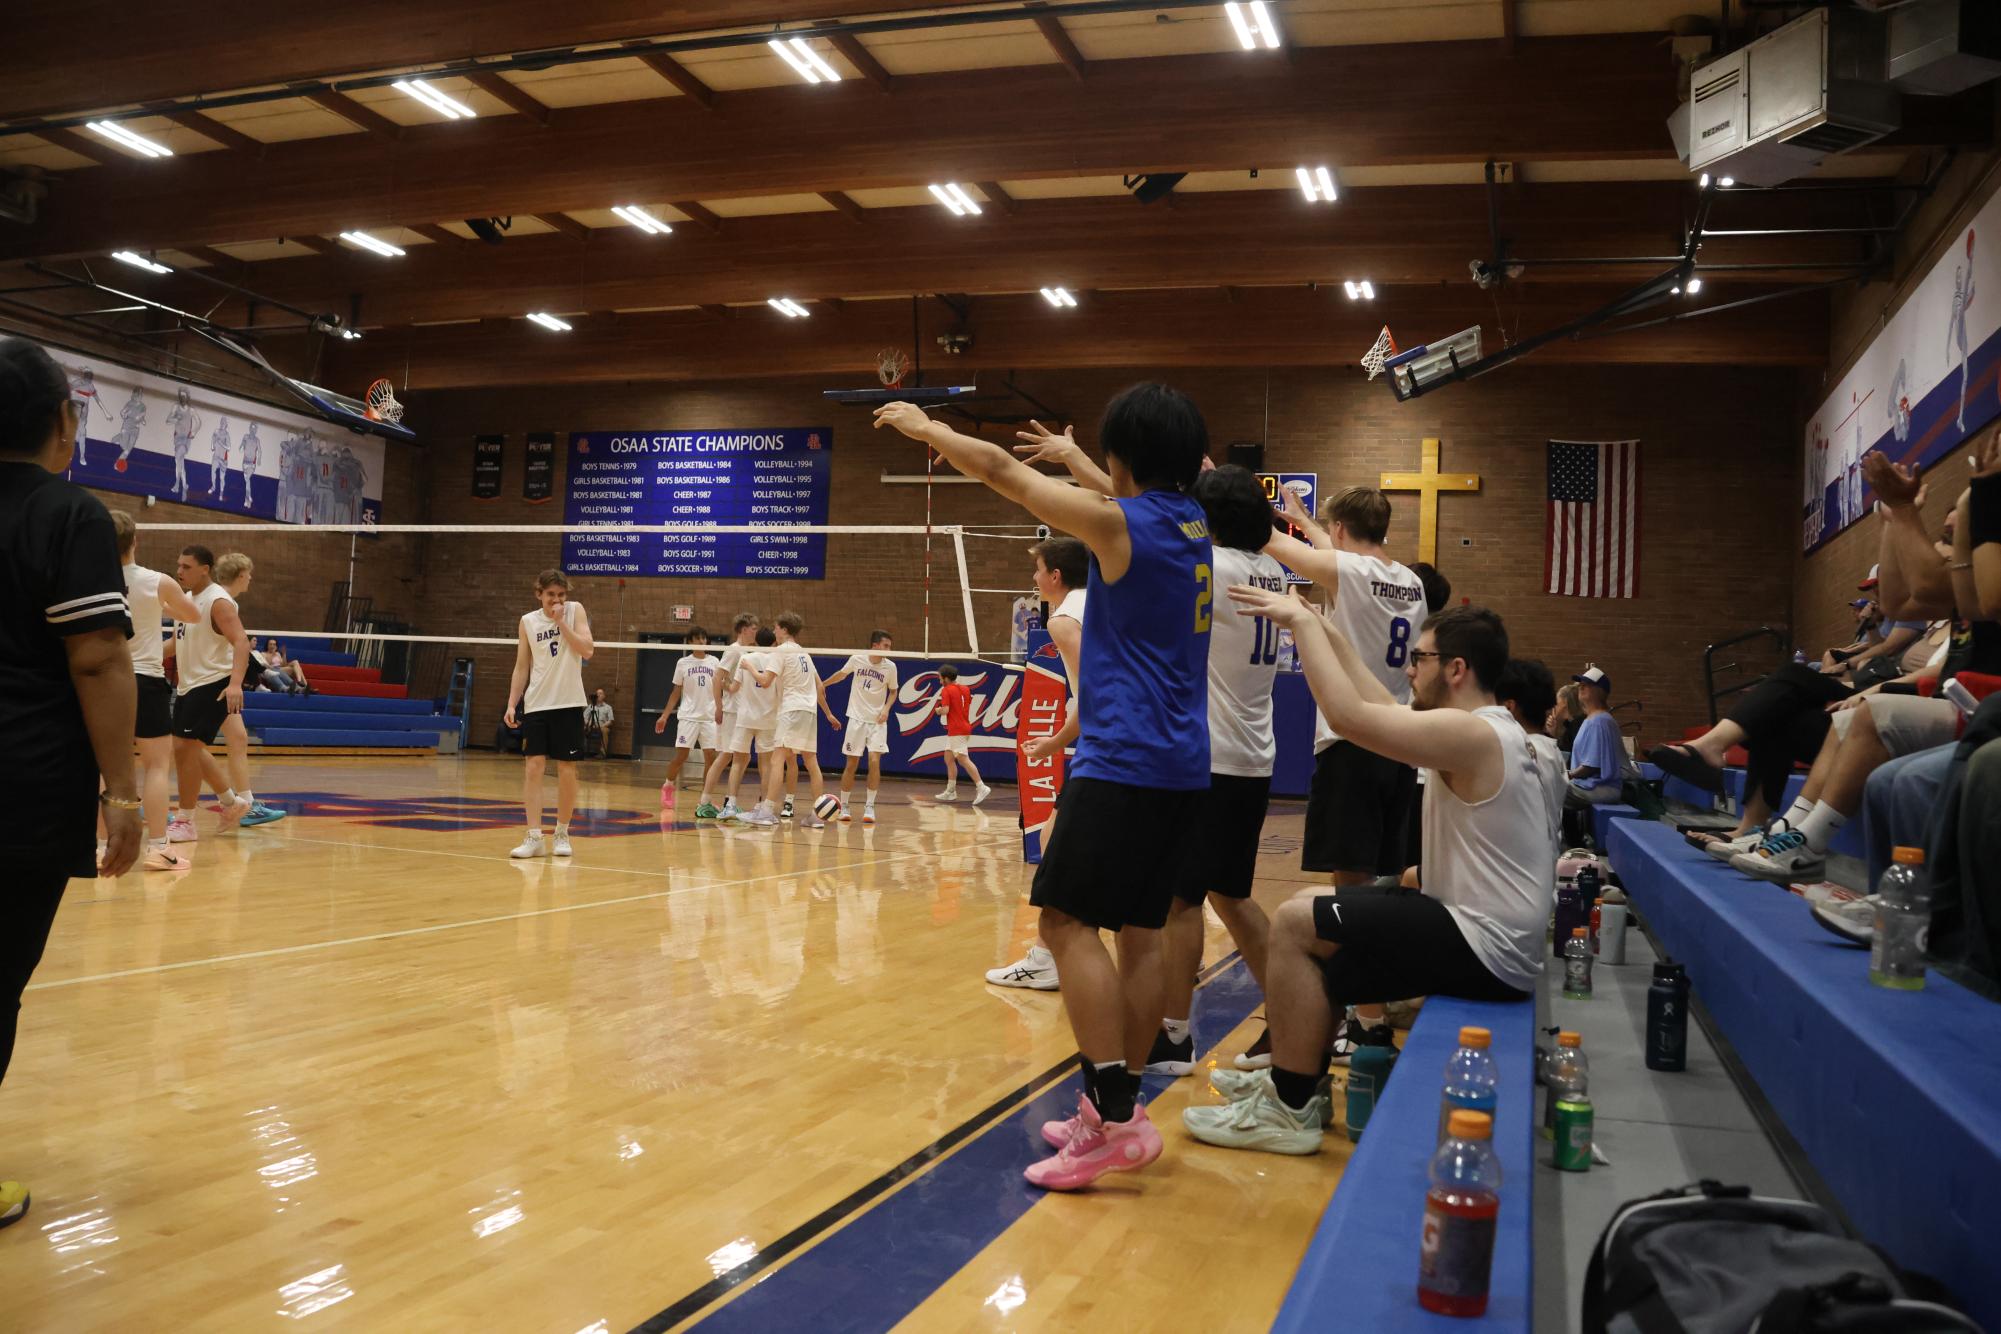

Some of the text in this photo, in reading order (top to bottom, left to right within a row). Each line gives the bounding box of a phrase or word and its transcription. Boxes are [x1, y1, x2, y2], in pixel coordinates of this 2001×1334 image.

[611, 436, 783, 452] OSAA STATE CHAMPIONS
[549, 640, 559, 658] 6
[1385, 616, 1411, 668] 8
[687, 666, 714, 678] FALCONS
[799, 656, 809, 673] 15
[697, 675, 706, 687] 13
[856, 668, 885, 684] FALCONS
[863, 679, 872, 691] 14
[1027, 699, 1058, 803] LA SLLE
